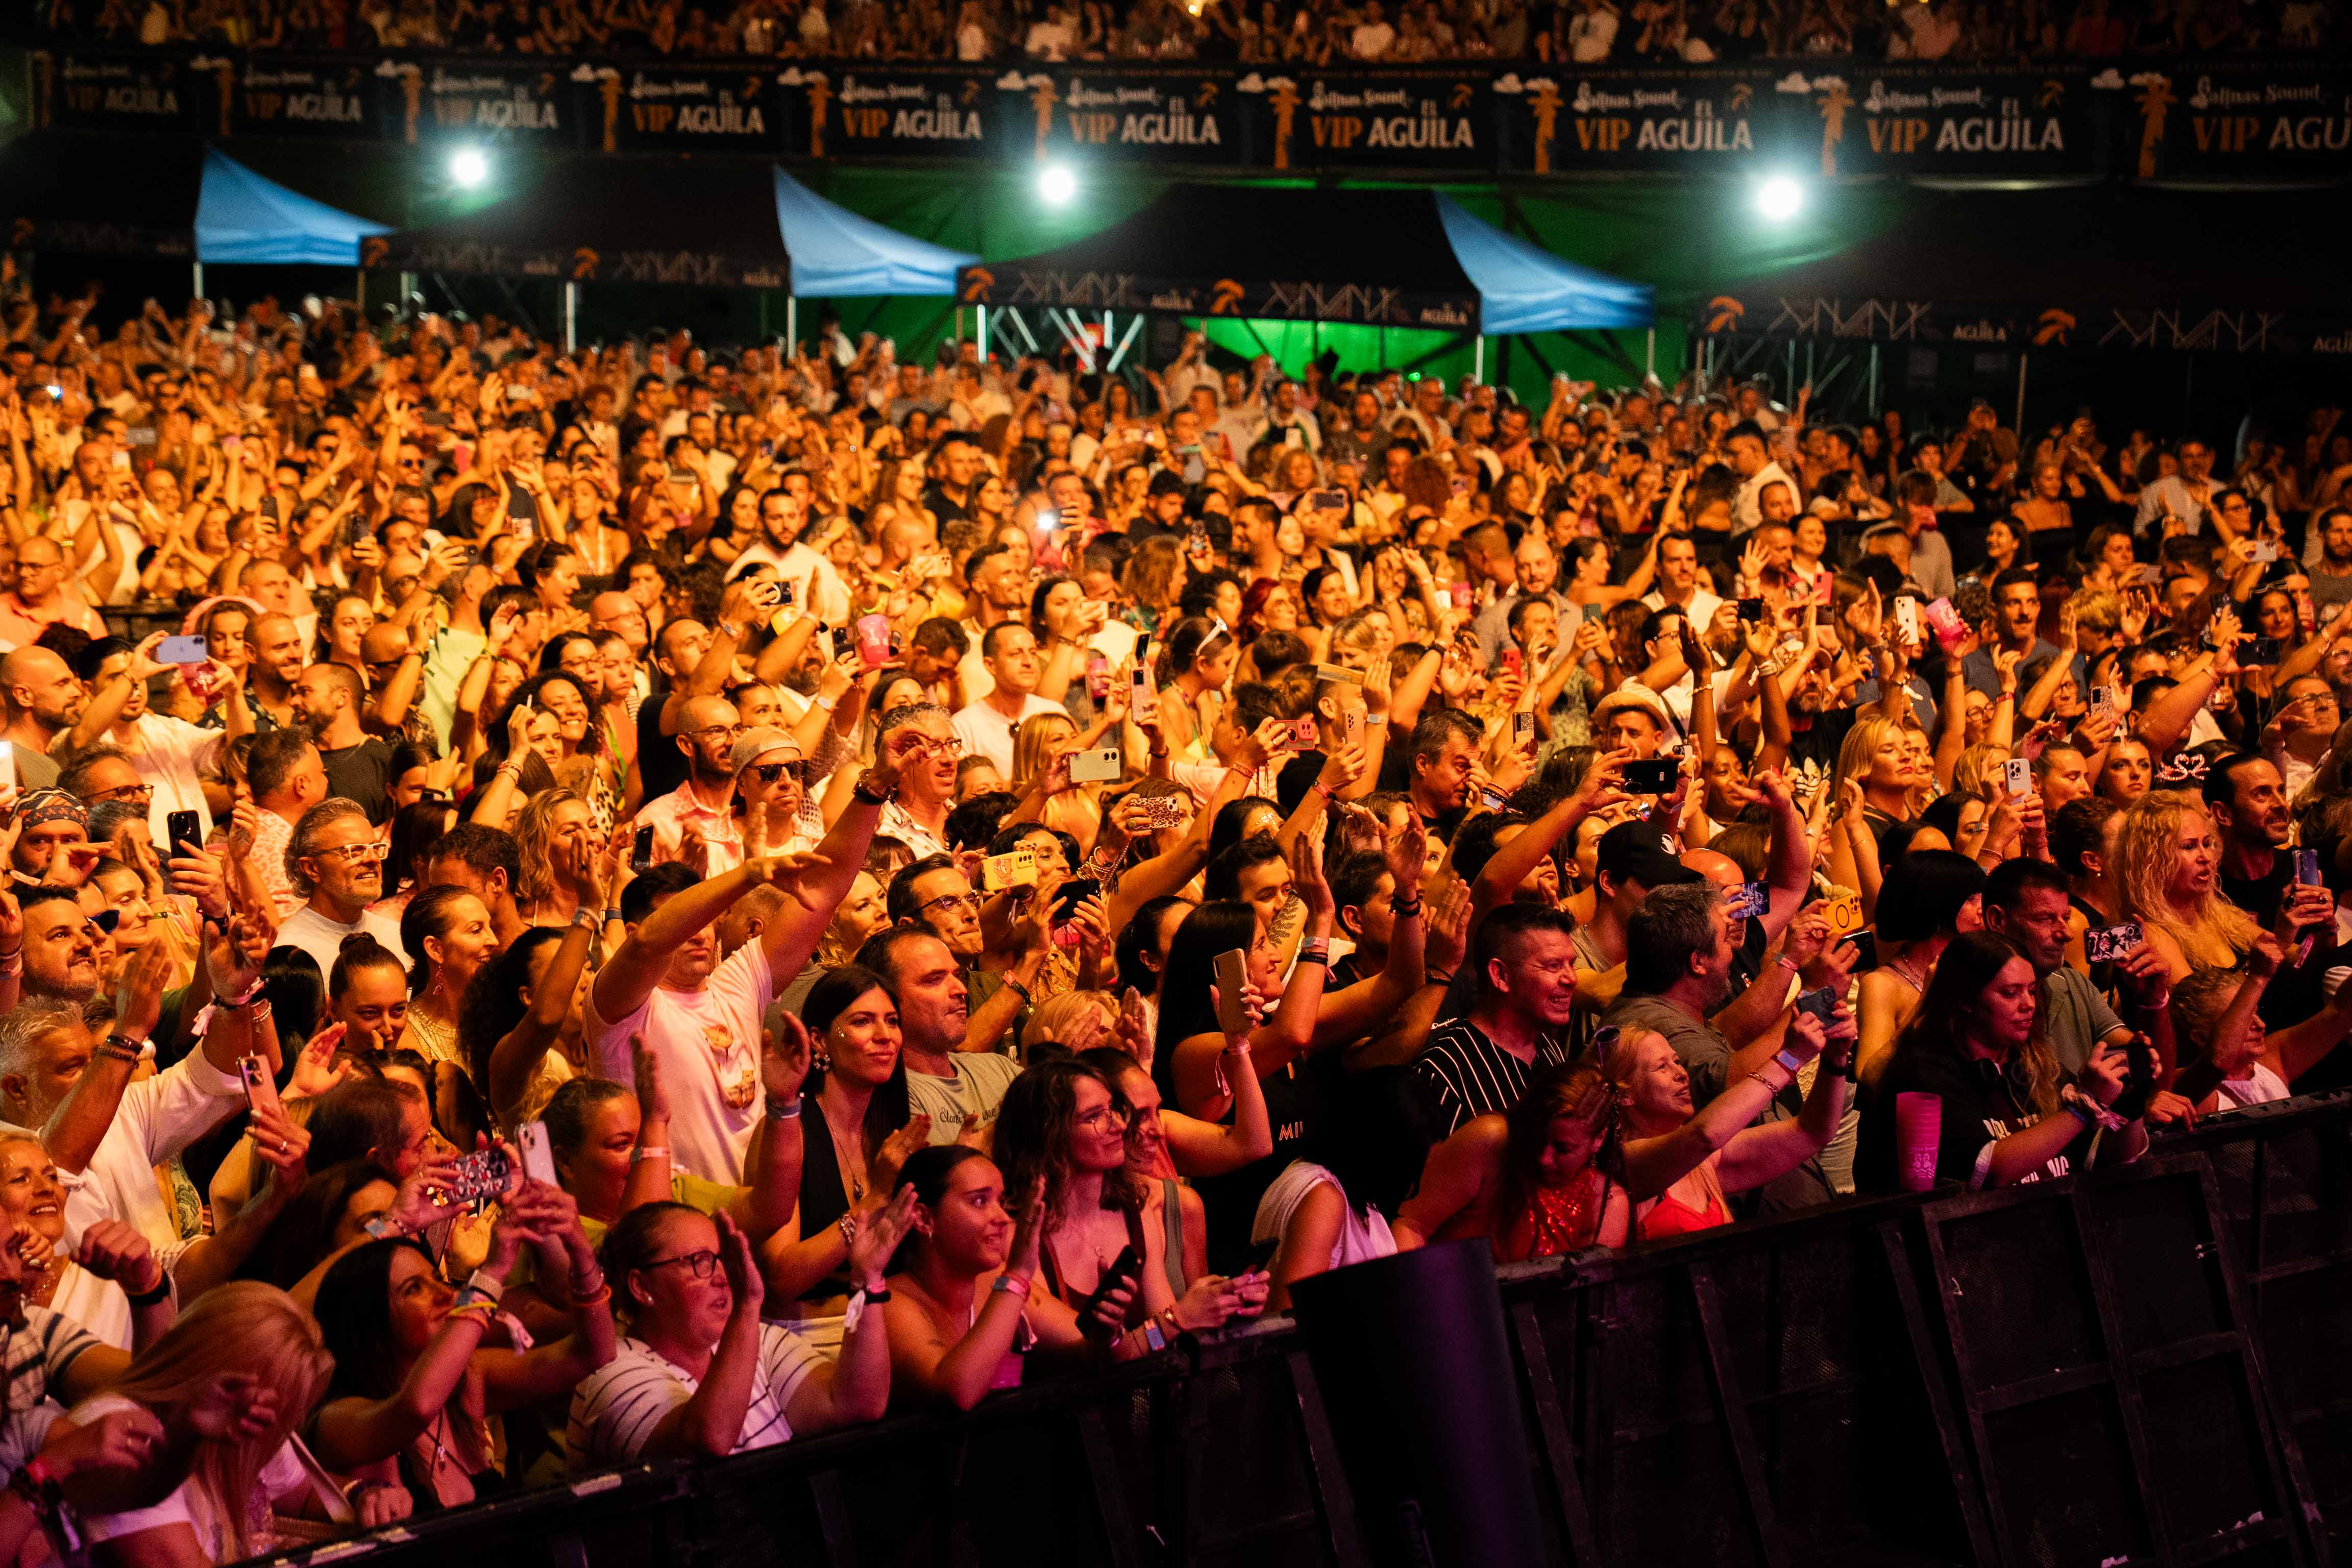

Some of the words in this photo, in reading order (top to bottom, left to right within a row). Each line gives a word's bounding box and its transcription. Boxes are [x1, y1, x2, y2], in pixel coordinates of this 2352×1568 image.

[632, 104, 673, 132] VIP
[842, 108, 889, 138] VIP
[1070, 114, 1117, 143] VIP
[1311, 116, 1363, 148] VIP
[2193, 115, 2260, 152] VIP
[1576, 118, 1631, 151] VIP
[1867, 118, 1929, 153] VIP
